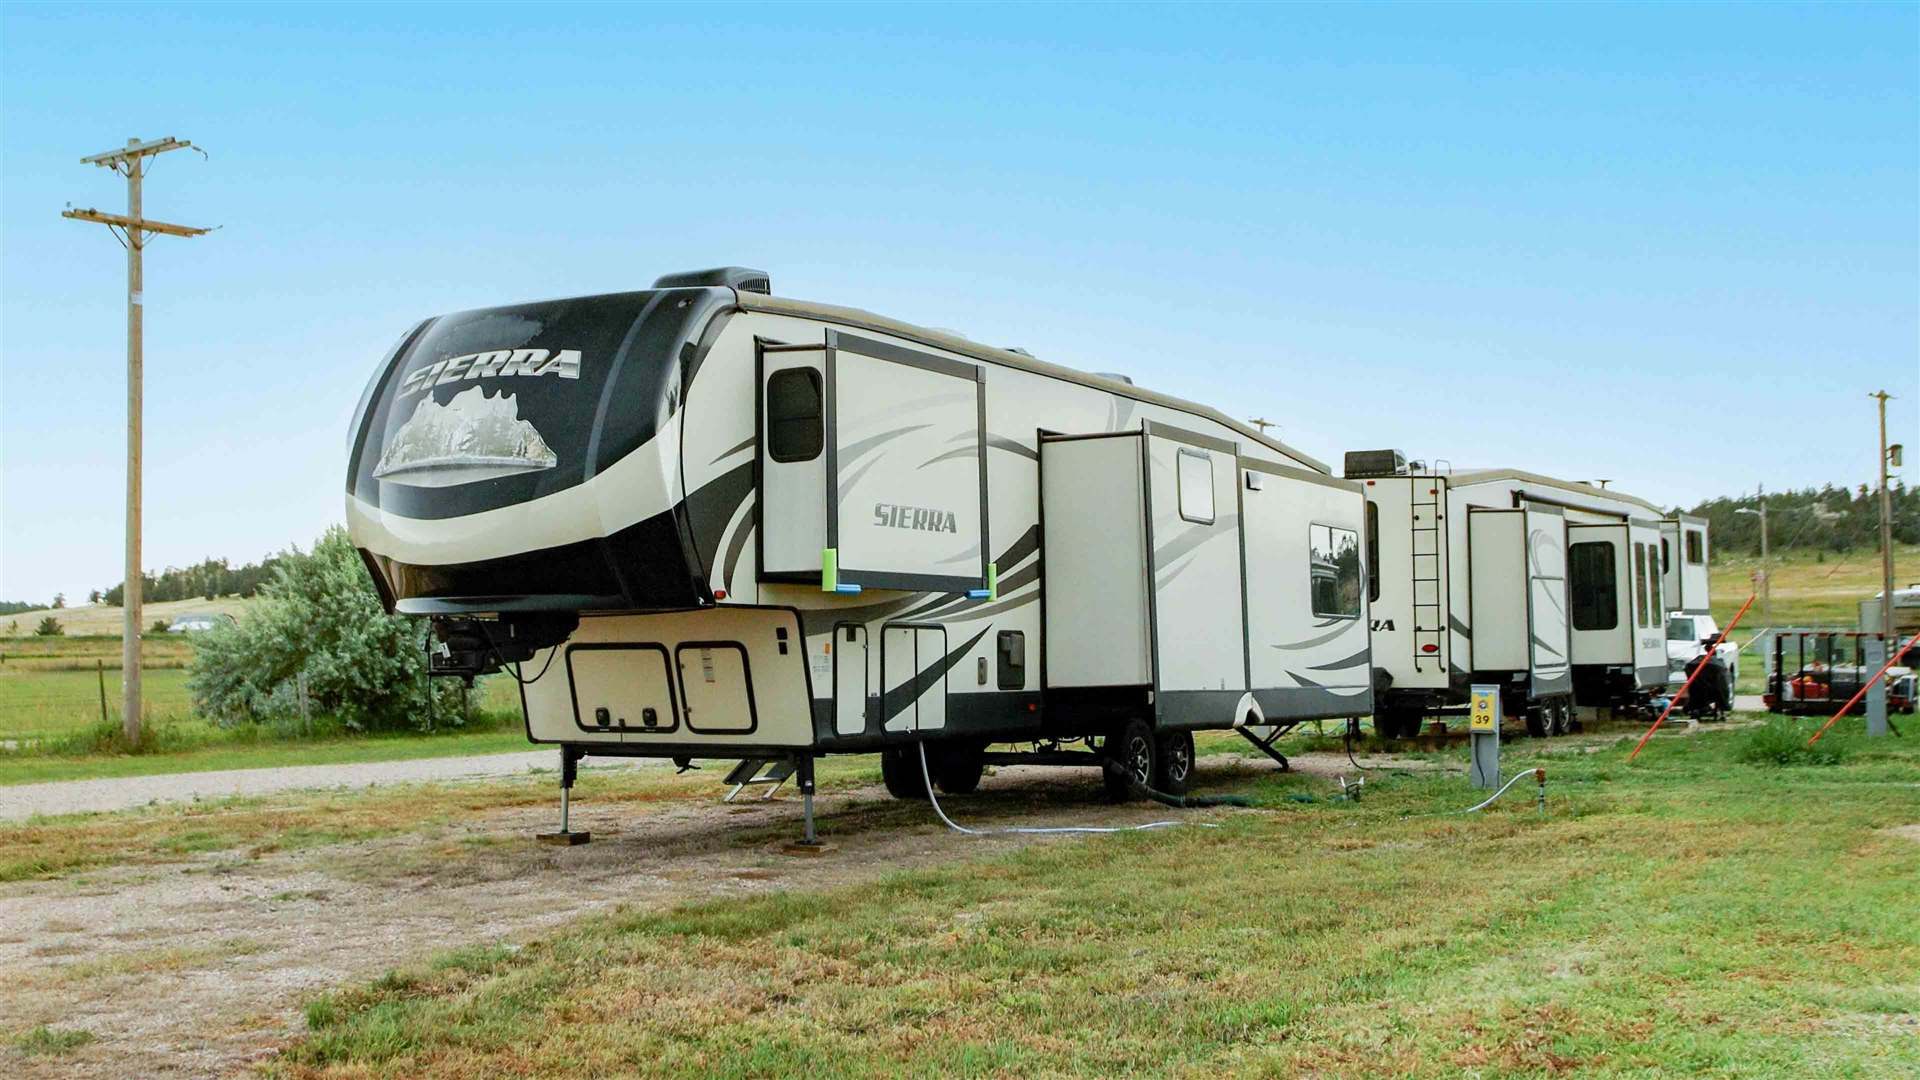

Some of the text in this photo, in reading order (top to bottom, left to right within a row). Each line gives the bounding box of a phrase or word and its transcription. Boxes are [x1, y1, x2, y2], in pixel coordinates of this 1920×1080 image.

[398, 349, 582, 399] SIERRA
[873, 502, 957, 533] SIERRA
[1475, 714, 1490, 725] 39
